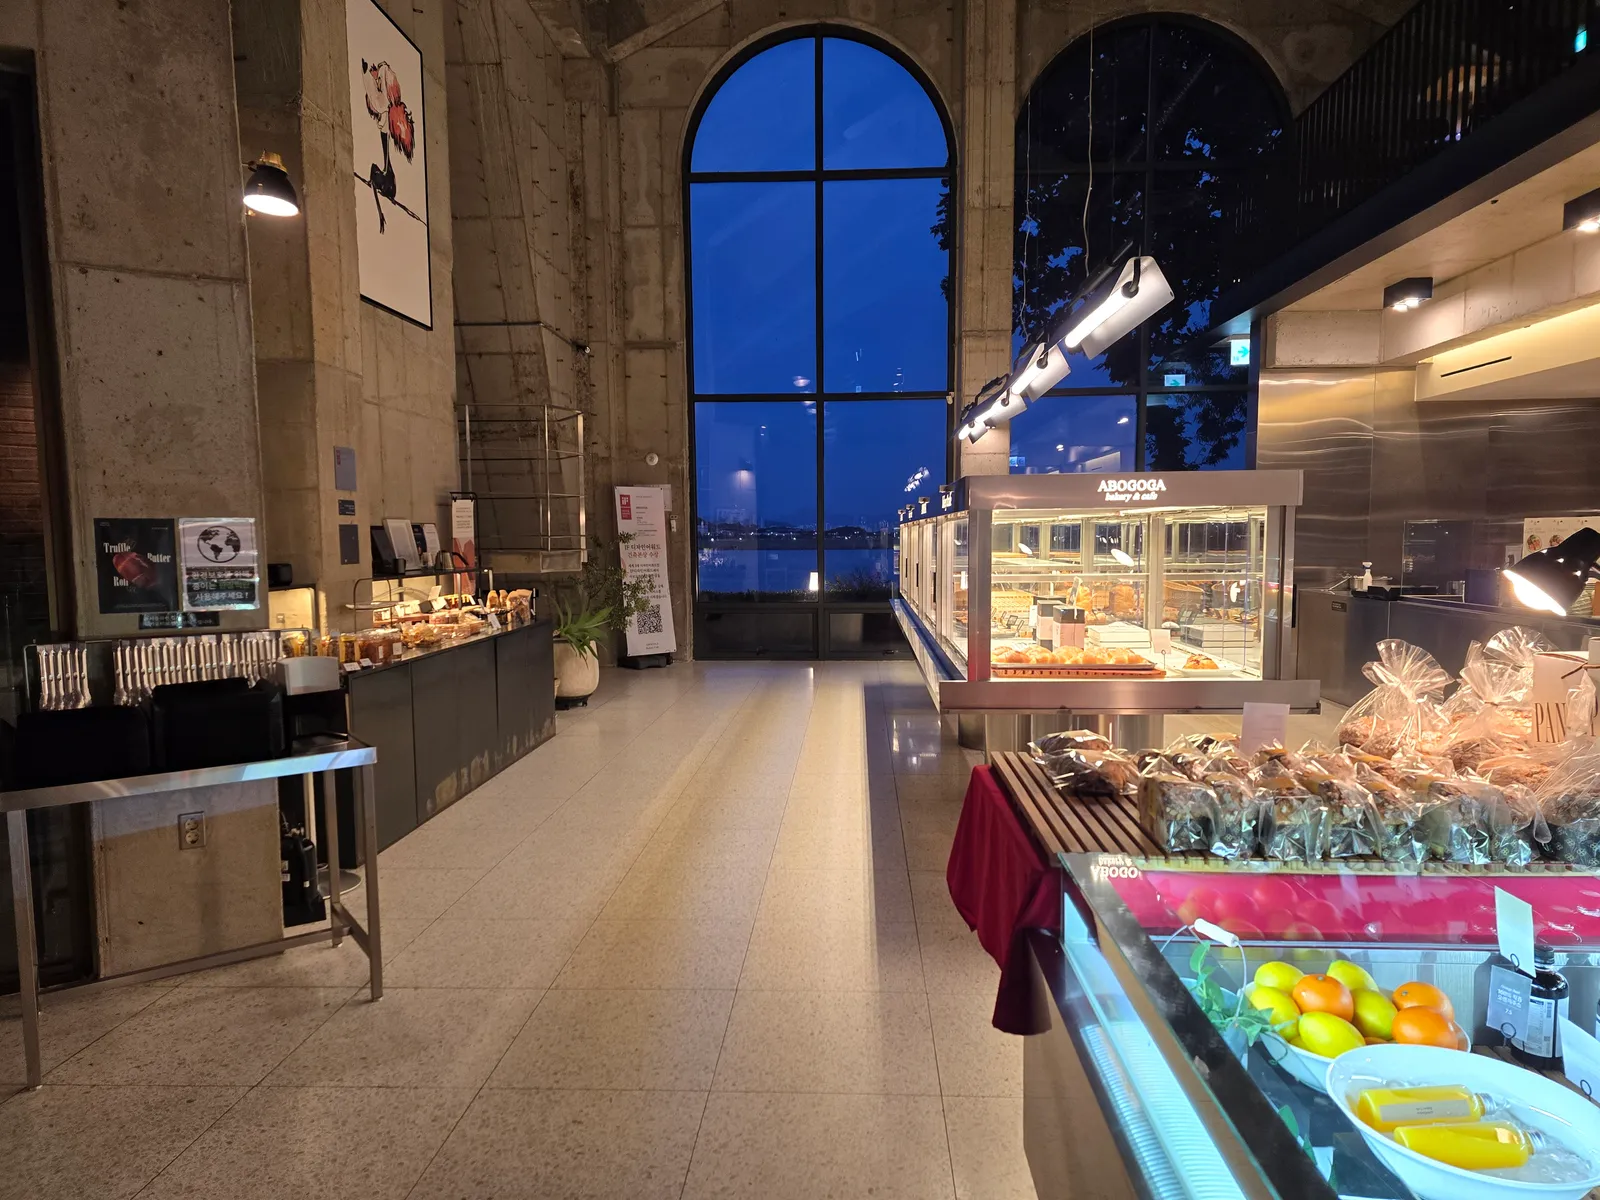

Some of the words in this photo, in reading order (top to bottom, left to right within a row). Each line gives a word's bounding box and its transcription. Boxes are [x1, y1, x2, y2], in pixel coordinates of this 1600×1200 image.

[1097, 479, 1166, 492] ABOGOGA
[1105, 492, 1132, 502] bakery
[1132, 492, 1140, 500] &
[103, 542, 131, 553] Truffle
[147, 552, 172, 563] Butter
[192, 582, 216, 590] 종이는
